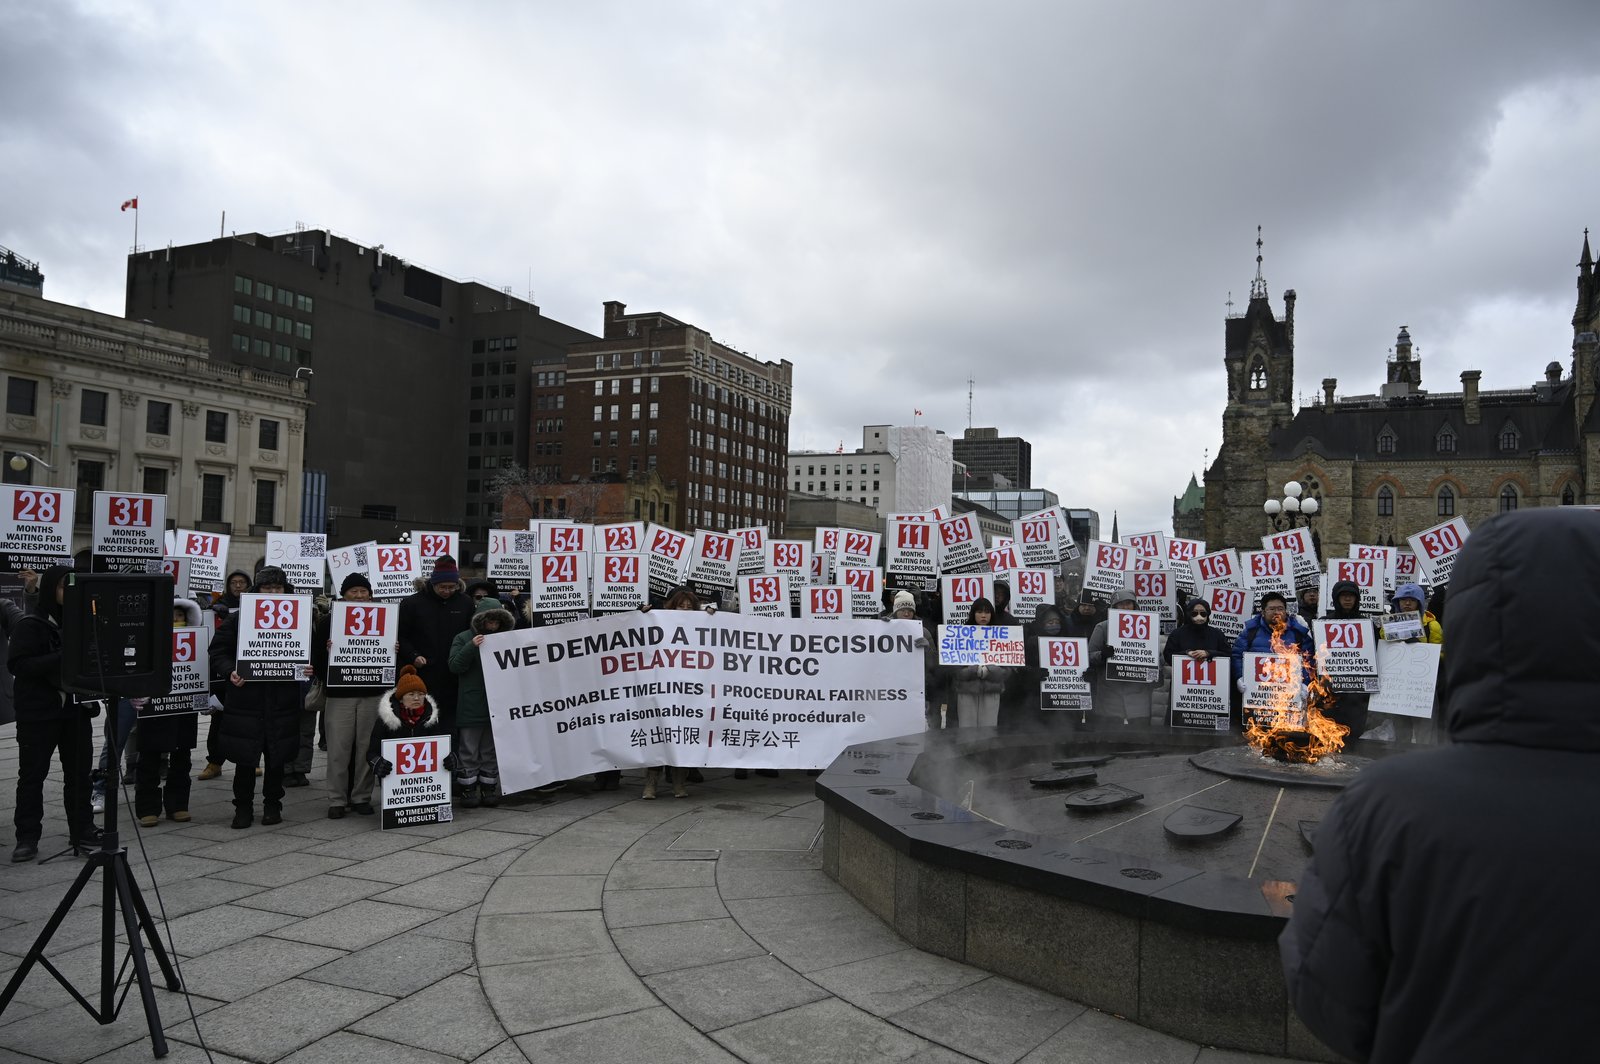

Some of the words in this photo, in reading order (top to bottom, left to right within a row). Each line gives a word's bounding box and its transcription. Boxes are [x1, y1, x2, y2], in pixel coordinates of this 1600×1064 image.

[18, 491, 55, 522] 28
[114, 497, 146, 526] 31
[7, 533, 43, 542] WAITING
[46, 535, 62, 543] FOR
[16, 525, 53, 534] MONTHS
[112, 529, 146, 537] MONTHS
[554, 529, 580, 552] 54
[608, 527, 633, 551] 23
[902, 525, 924, 549] 11
[944, 519, 968, 544] 39
[1025, 521, 1047, 543] 20
[22, 542, 67, 551] RESPONSE
[103, 537, 137, 545] WAITING
[139, 538, 155, 546] FOR
[117, 546, 159, 554] RESPONSE
[189, 535, 214, 556] 31
[424, 535, 447, 557] 32
[491, 535, 507, 554] 31
[654, 532, 679, 558] 25
[706, 536, 729, 560] 31
[847, 533, 869, 555] 22
[948, 542, 972, 553] MONTHS
[1134, 535, 1155, 557] 34
[1172, 541, 1193, 560] 34
[1278, 534, 1299, 554] 19
[1426, 527, 1458, 556] 30
[381, 548, 408, 571] 23
[777, 544, 800, 567] 39
[942, 560, 955, 568] IRCC
[955, 553, 984, 564] RESPONSE
[944, 550, 967, 560] WAITING
[968, 547, 980, 555] FOR
[991, 549, 1011, 572] 27
[1100, 546, 1124, 570] 39
[1254, 553, 1280, 576] 30
[546, 557, 573, 582] 24
[608, 557, 635, 583] 34
[695, 566, 719, 576] WAITING
[703, 561, 726, 570] MONTHS
[1098, 570, 1122, 578] MONTHS
[1203, 555, 1226, 579] 16
[1343, 563, 1370, 586] 30
[547, 585, 574, 593] MONTHS
[753, 578, 777, 602] 53
[849, 570, 870, 591] 27
[955, 578, 980, 601] 40
[1022, 572, 1043, 594] 39
[1138, 574, 1163, 596] 36
[1432, 574, 1447, 584] IRCC
[540, 593, 567, 601] WAITING
[551, 600, 585, 608] RESPONSE
[815, 589, 838, 613] 19
[1215, 590, 1242, 613] 30
[258, 600, 294, 629] 38
[350, 607, 380, 636] 31
[1212, 614, 1238, 622] MONTHS
[946, 625, 977, 639] STOP
[981, 627, 1009, 639] THE
[1122, 615, 1148, 639] 36
[1328, 624, 1359, 648] 20
[348, 638, 380, 646] MONTHS
[494, 646, 540, 670] WE
[547, 625, 664, 663] DEMAND
[671, 627, 689, 645] A
[695, 627, 783, 651] TIMELY
[790, 634, 913, 653] DECISION
[1114, 648, 1139, 656] WAITING
[601, 648, 715, 675] DELAYED
[723, 652, 753, 672] BY
[759, 655, 820, 676] IRCC
[1052, 642, 1076, 666] 39
[185, 673, 200, 681] FOR
[1187, 661, 1211, 685] 11
[509, 687, 619, 720] REASONABLE
[622, 682, 704, 699] TIMELINES
[723, 684, 825, 701] PROCEDURAL
[829, 689, 908, 701] FAIRNESS
[557, 713, 605, 734] Délais
[610, 705, 704, 723] raisonnables
[722, 704, 769, 722] Équité
[772, 710, 866, 725] procédurale
[630, 726, 700, 748] 给出时限
[721, 728, 801, 749] 程序公平
[400, 742, 433, 773] 34
[392, 786, 425, 796] WAITING
[427, 784, 441, 792] FOR
[401, 776, 433, 786] MONTHS
[387, 797, 405, 805] IRCC
[406, 792, 446, 804] RESPONSE
[405, 806, 438, 815] TIMELINES
[408, 814, 436, 823] RESULTS
